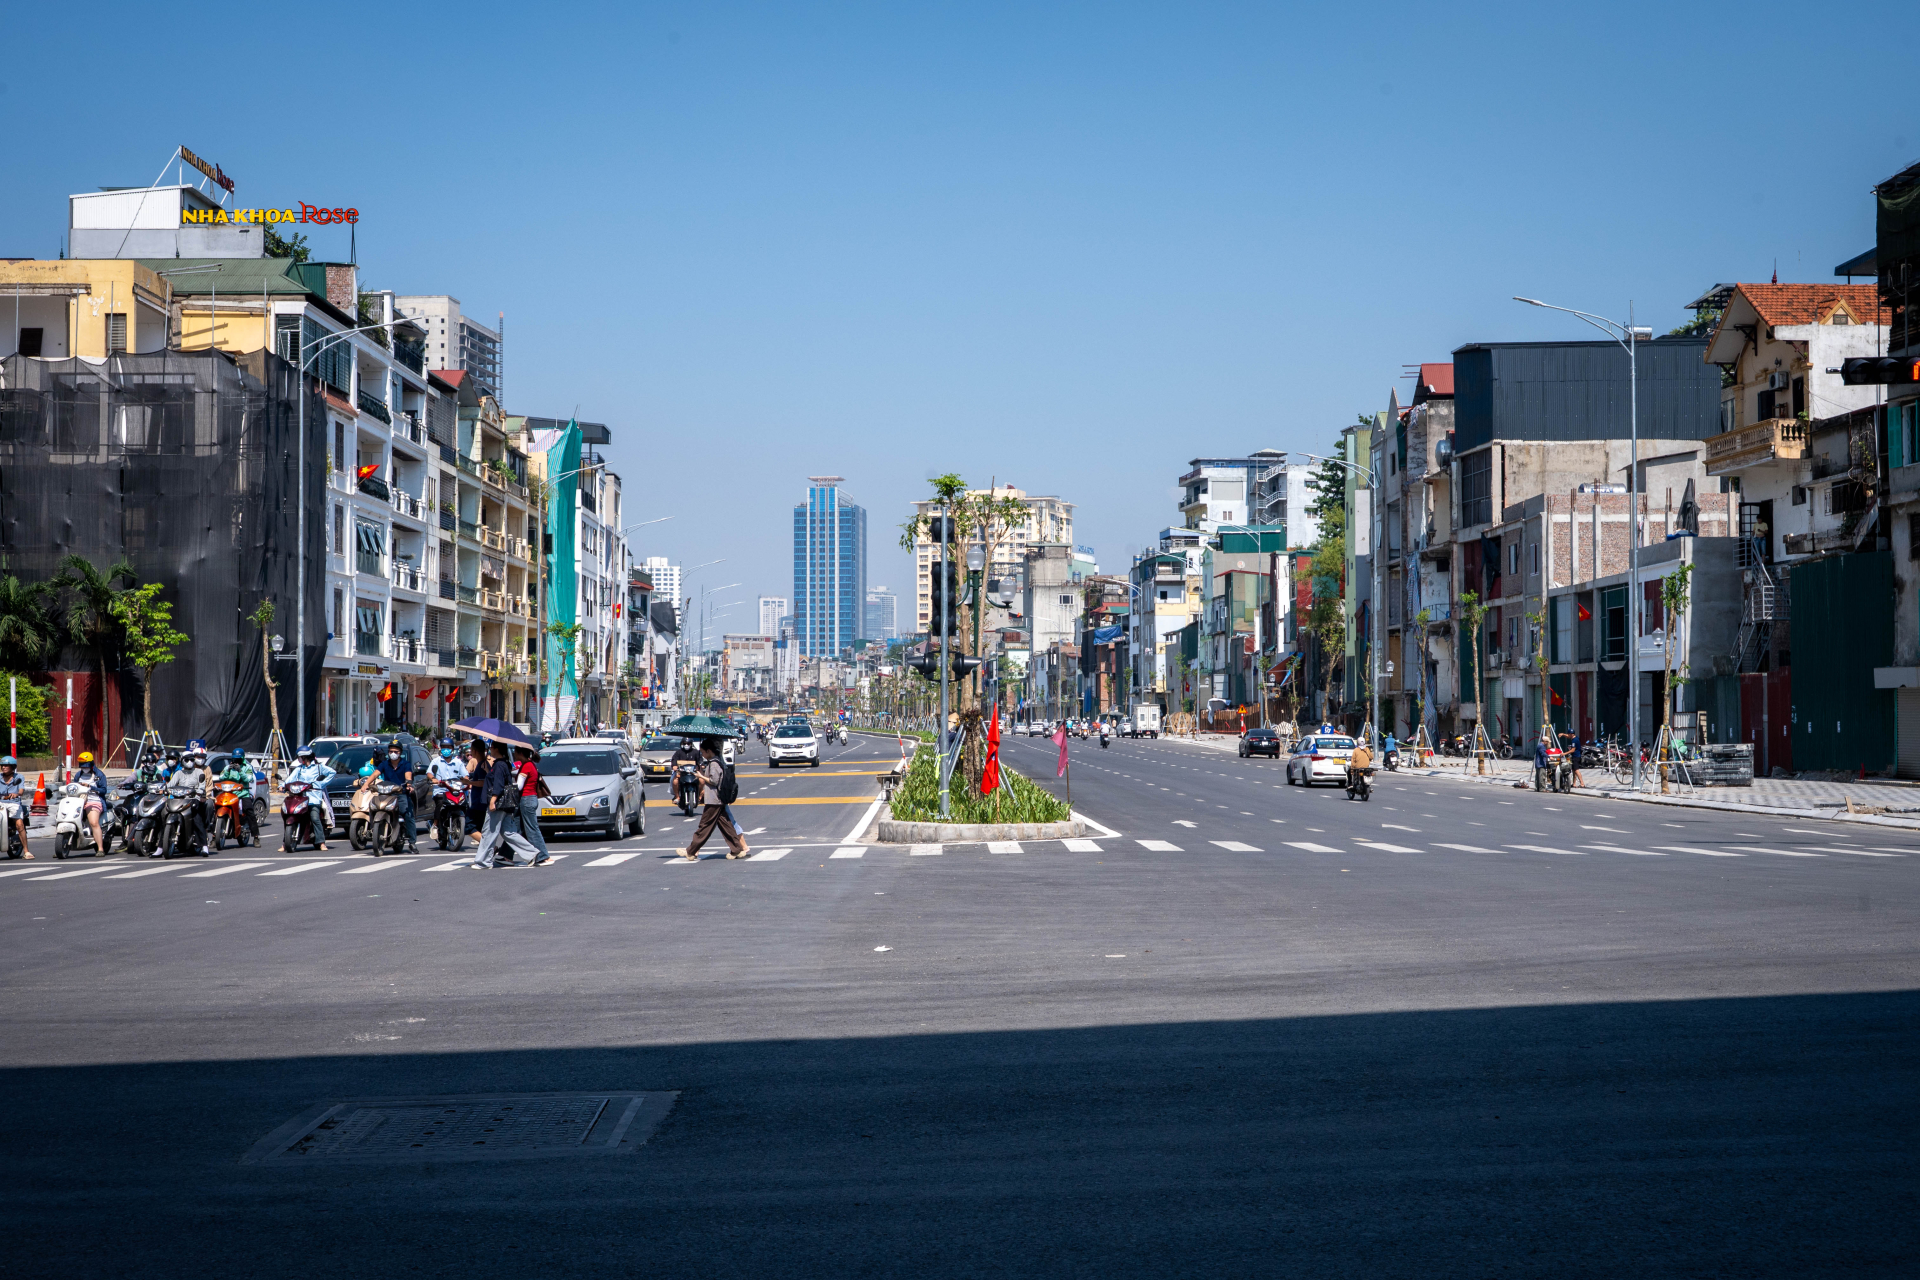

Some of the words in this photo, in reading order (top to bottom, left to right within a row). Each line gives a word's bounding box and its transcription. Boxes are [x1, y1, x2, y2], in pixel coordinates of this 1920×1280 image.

[182, 146, 197, 167] NHA
[197, 157, 217, 181] KHOA
[216, 163, 235, 194] Rose
[182, 209, 229, 223] NHA
[234, 208, 296, 223] KHOA
[298, 201, 359, 225] Rose
